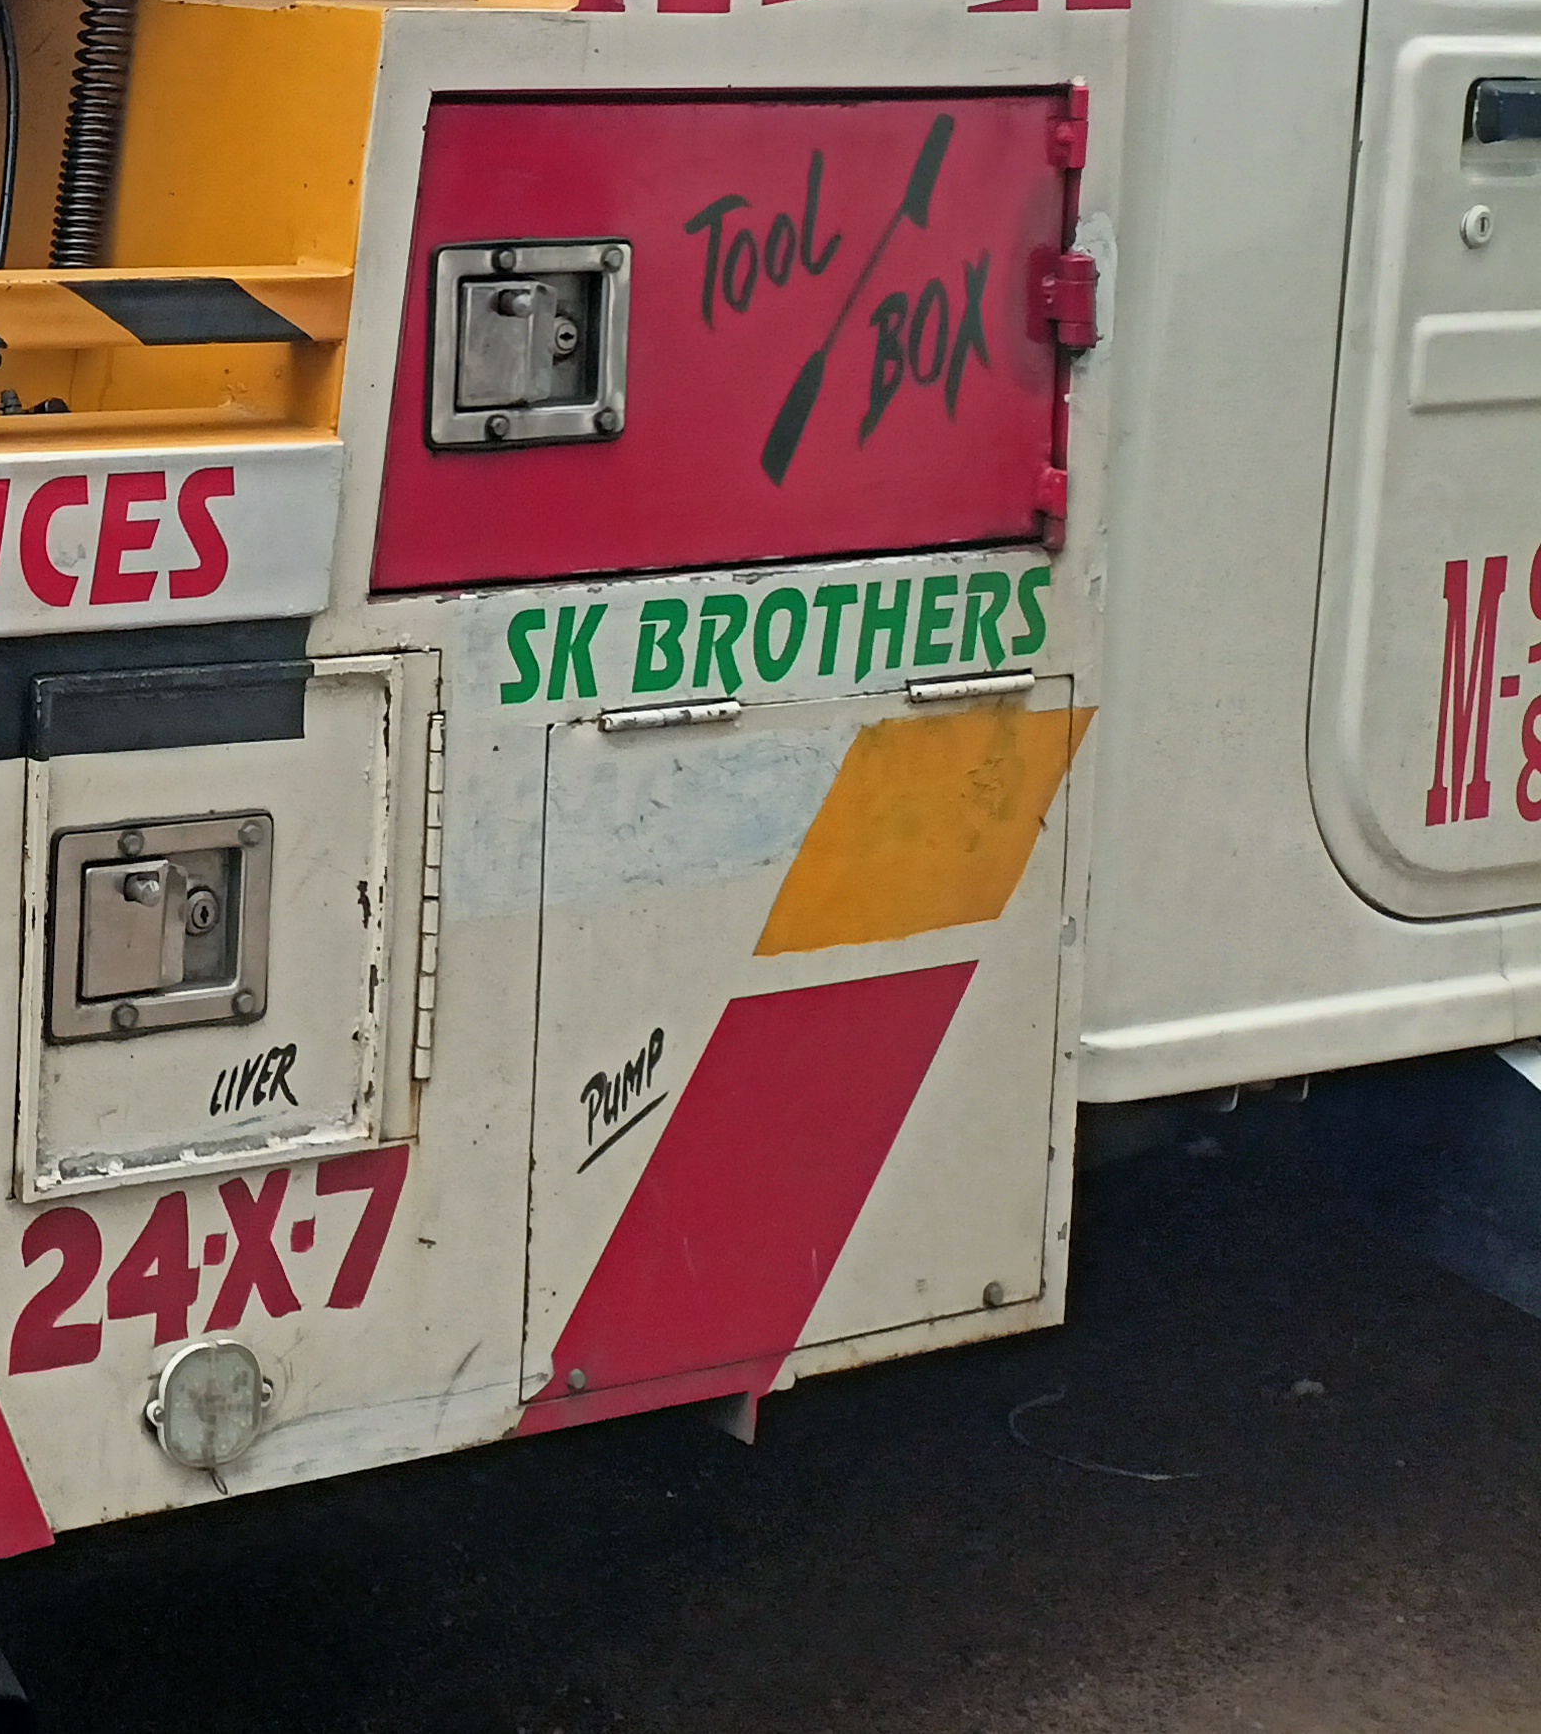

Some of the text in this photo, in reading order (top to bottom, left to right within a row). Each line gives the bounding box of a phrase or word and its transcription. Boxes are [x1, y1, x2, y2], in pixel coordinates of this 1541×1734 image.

[857, 248, 993, 450] BOX
[499, 566, 1051, 705] SK BROTHERS
[209, 1042, 299, 1117] LIVER
[580, 1027, 665, 1147] PUMP
